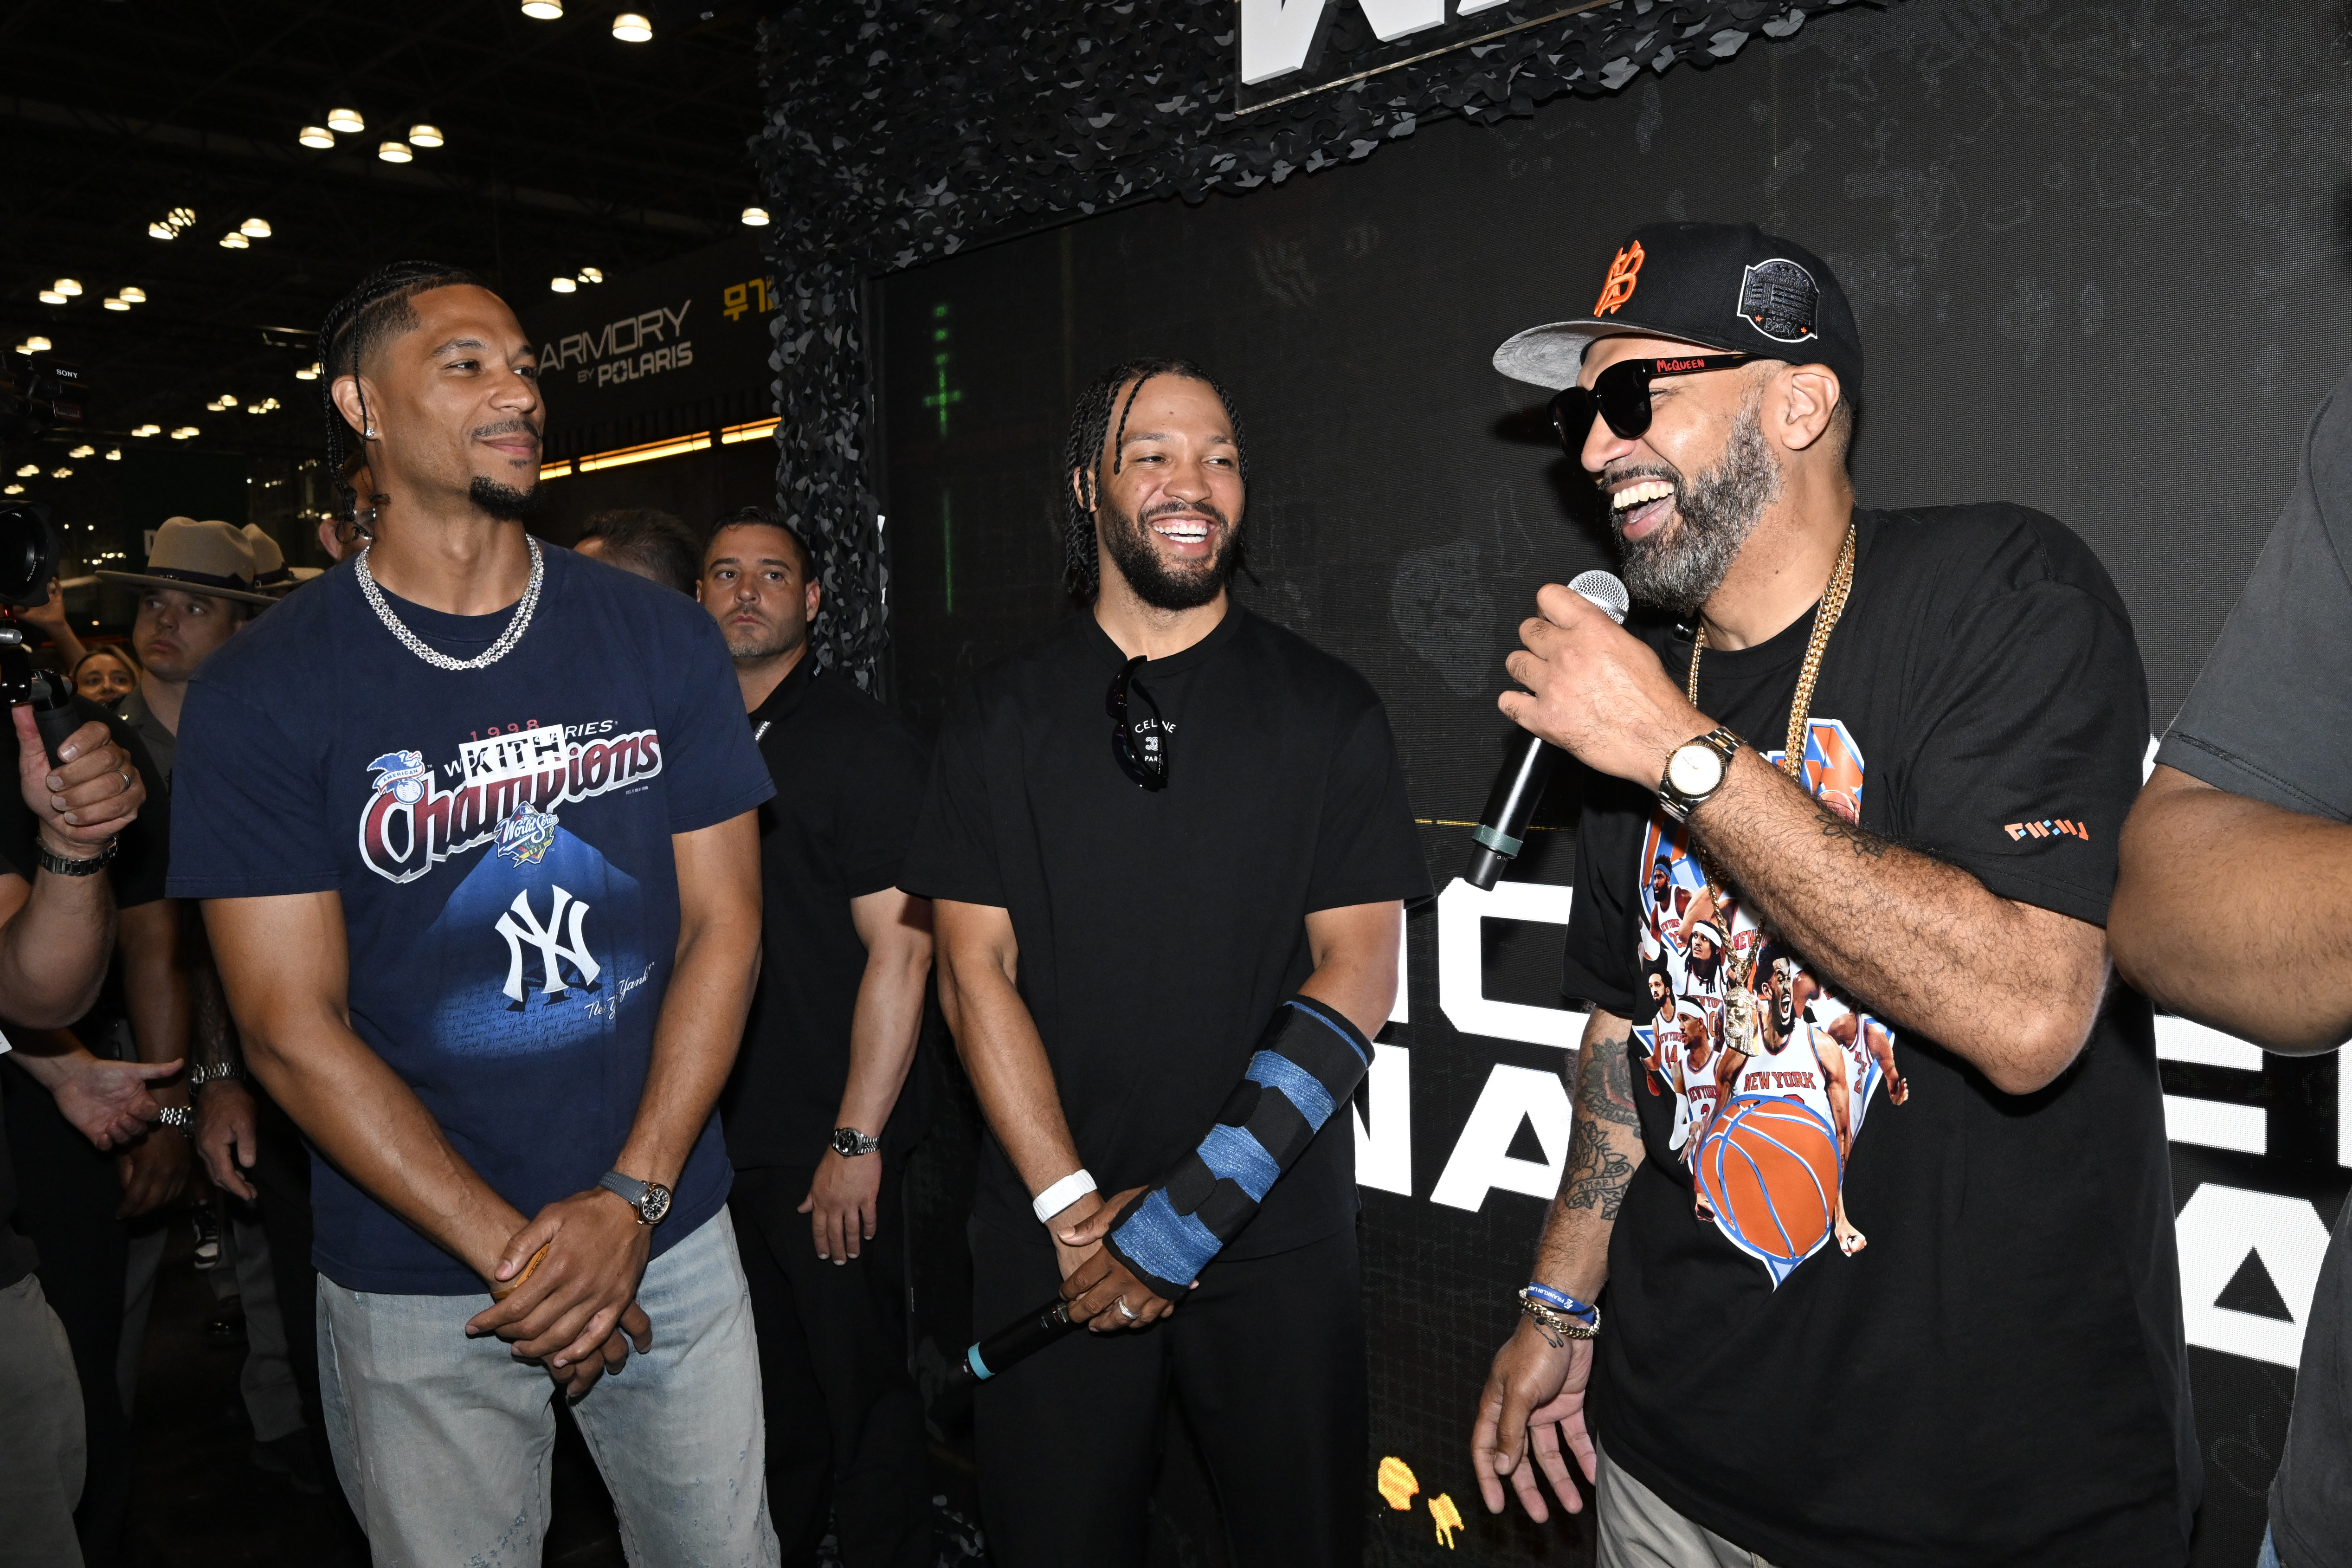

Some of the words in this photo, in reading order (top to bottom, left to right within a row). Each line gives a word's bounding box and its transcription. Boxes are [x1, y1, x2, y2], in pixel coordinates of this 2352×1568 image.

[538, 299, 691, 377] ARMORY
[56, 368, 78, 379] SONY
[577, 369, 594, 384] BY
[598, 341, 693, 388] POLARIS
[1656, 358, 1705, 373] McQUEEN
[467, 732, 561, 779] KITH
[382, 768, 419, 782] AMERICAN
[359, 729, 663, 884] Champions
[499, 818, 536, 844] World
[531, 813, 558, 844] Series
[1743, 1071, 1770, 1092] NEW
[1771, 1071, 1817, 1090] YORK
[1535, 1286, 1565, 1303] FRANKLIN
